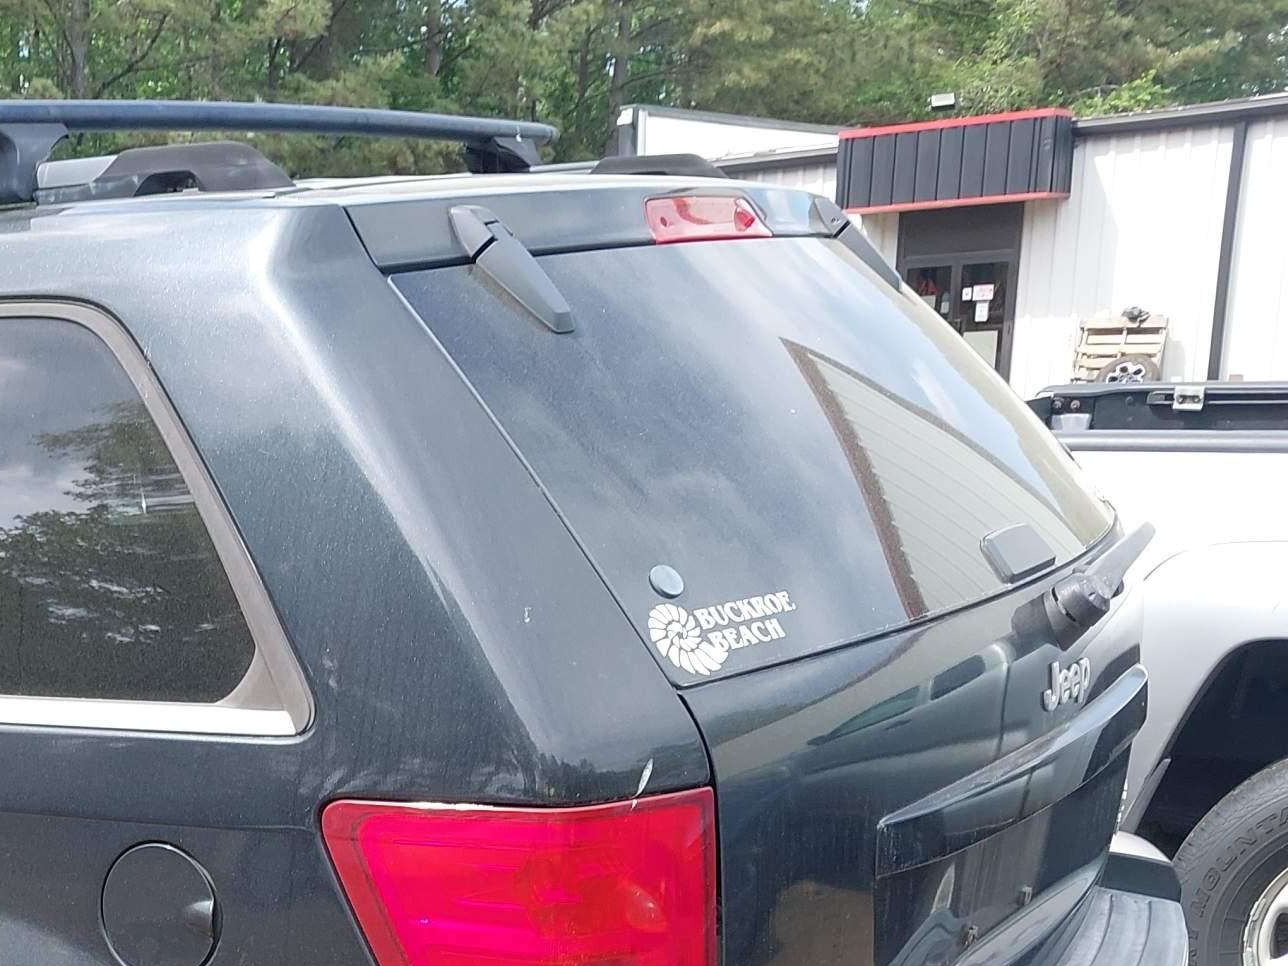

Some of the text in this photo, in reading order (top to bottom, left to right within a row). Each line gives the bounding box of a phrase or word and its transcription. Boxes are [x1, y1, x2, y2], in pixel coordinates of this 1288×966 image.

[693, 591, 796, 630] BUCKROE
[705, 618, 787, 652] BEACH
[1043, 657, 1091, 711] Jeep
